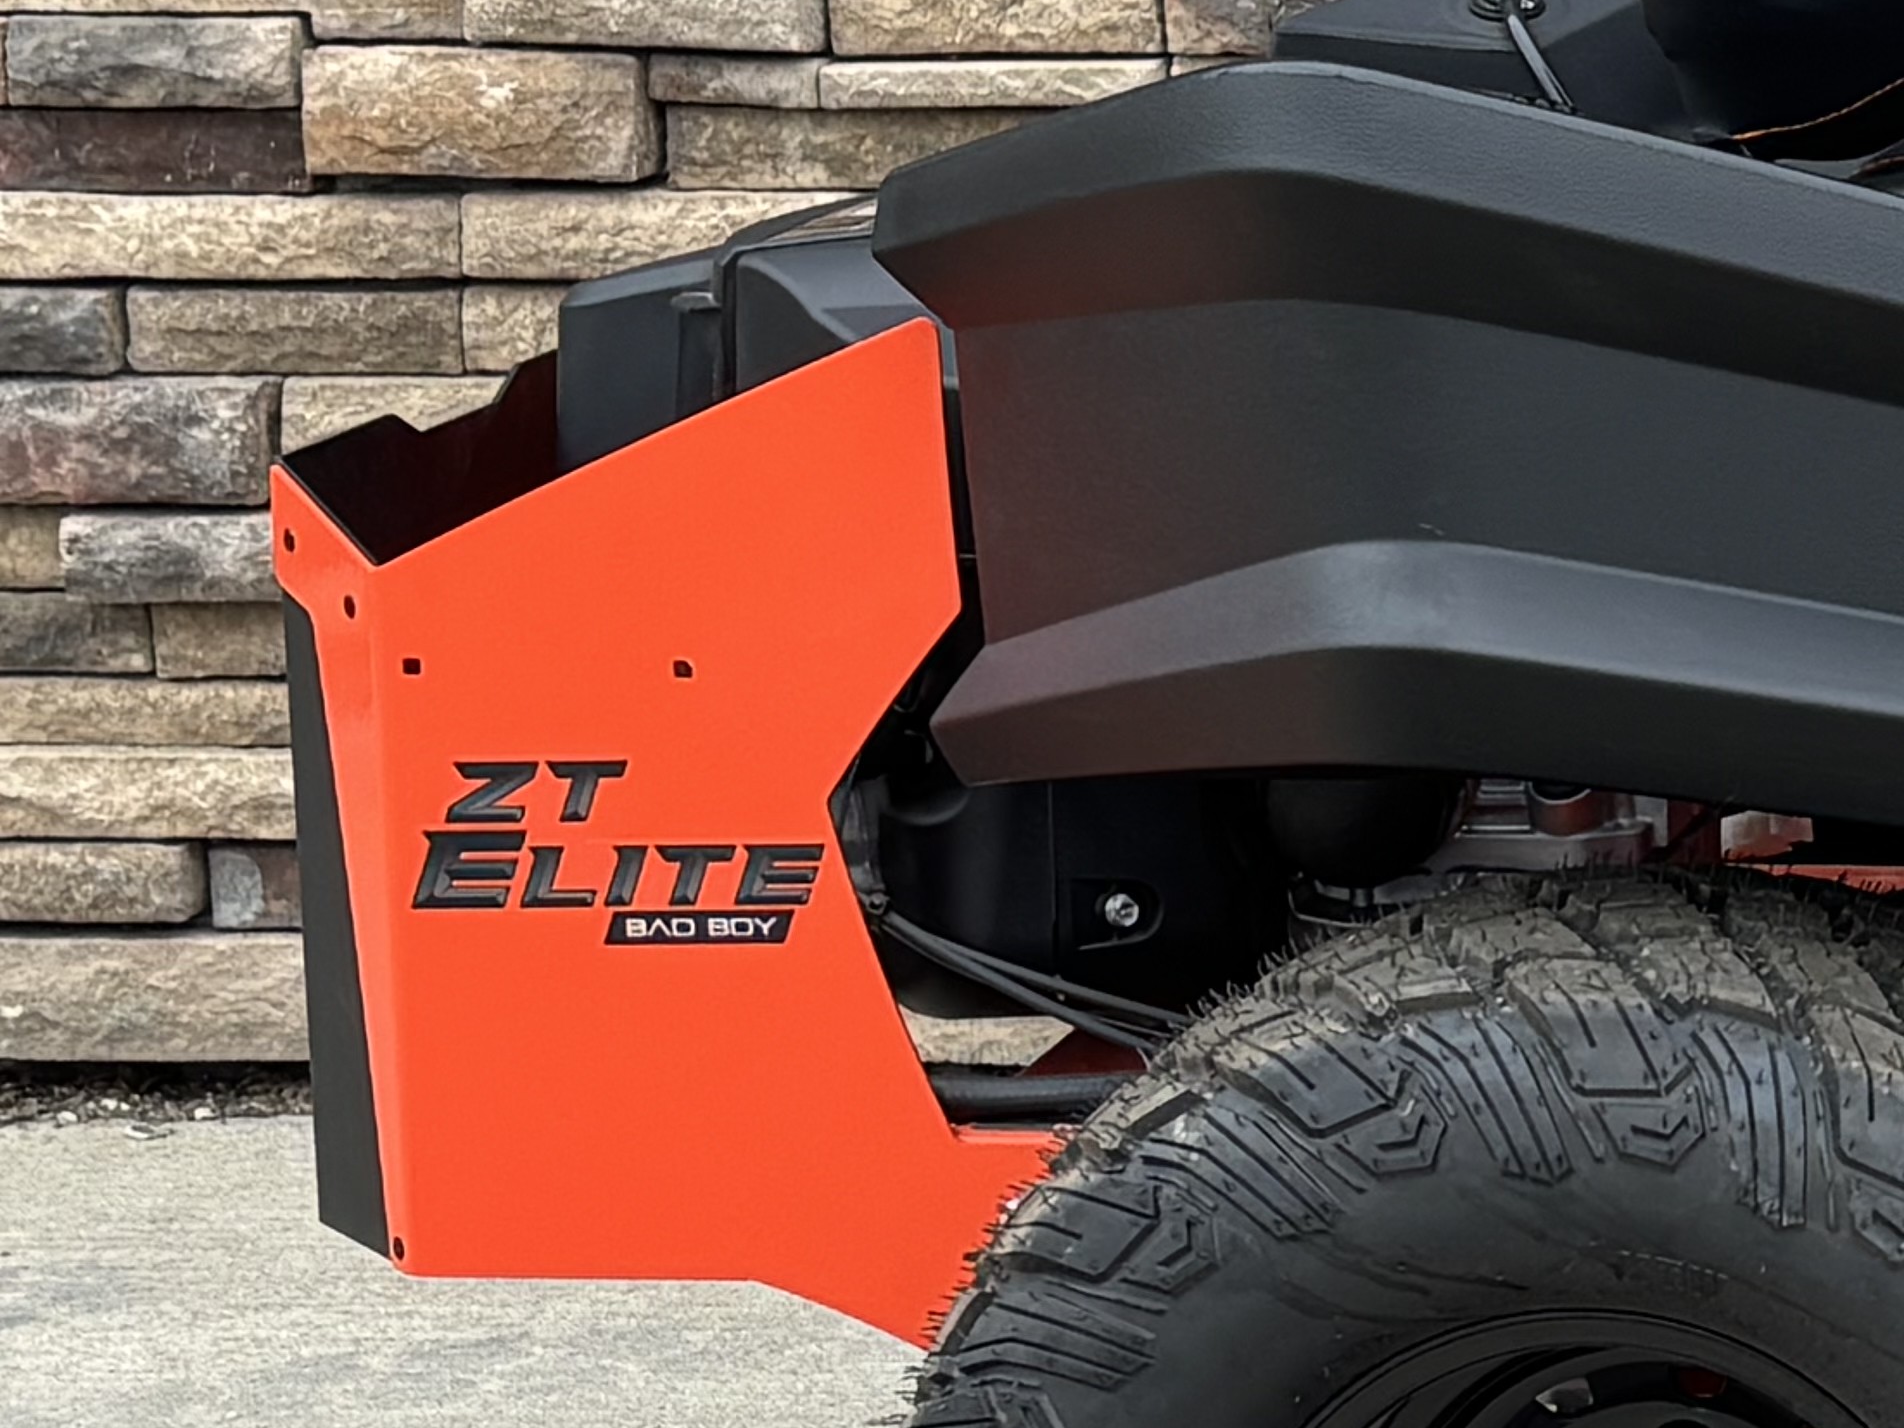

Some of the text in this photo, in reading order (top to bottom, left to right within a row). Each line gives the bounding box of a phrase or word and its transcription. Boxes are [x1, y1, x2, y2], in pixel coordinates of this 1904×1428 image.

[444, 759, 628, 822] ZT
[411, 829, 825, 909] ELITE
[625, 916, 779, 938] BAD BOY
